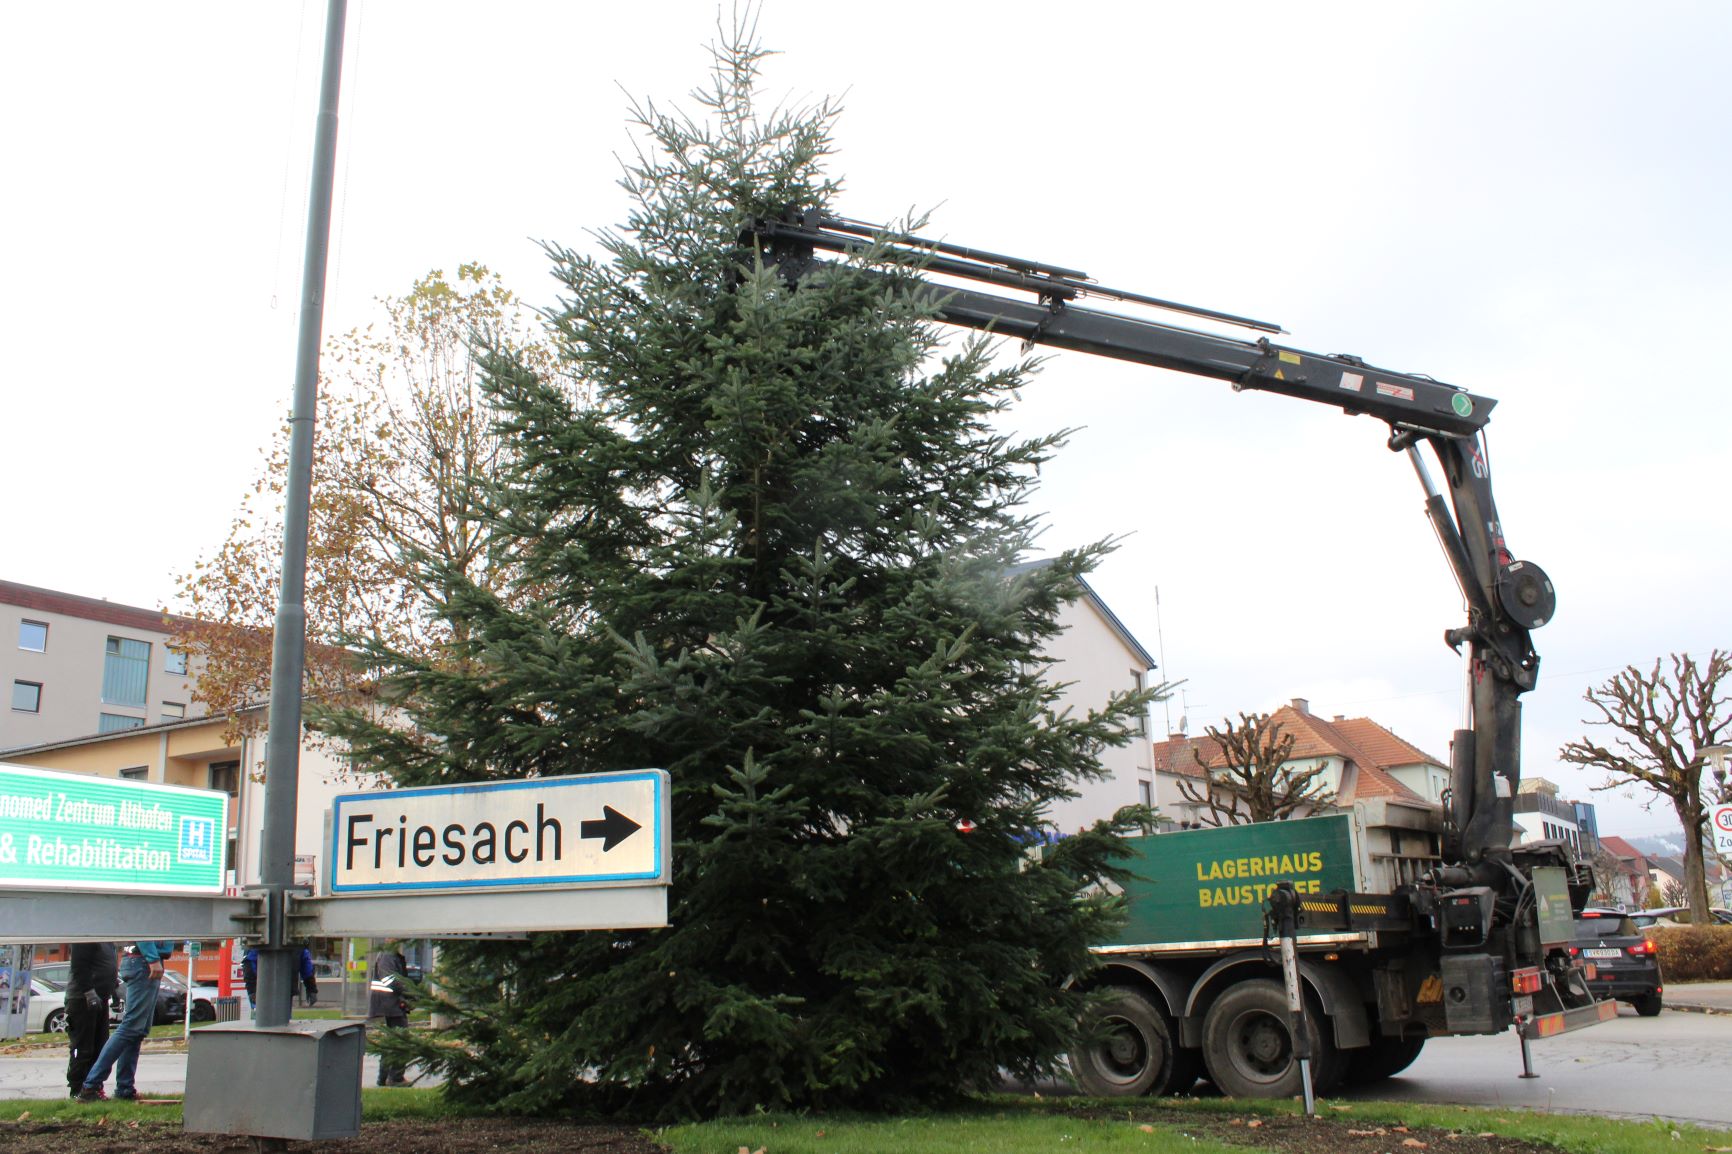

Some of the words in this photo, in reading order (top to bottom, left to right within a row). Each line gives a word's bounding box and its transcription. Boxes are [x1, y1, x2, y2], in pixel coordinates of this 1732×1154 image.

[55, 793, 115, 825] Zentrum
[118, 800, 172, 831] Althofen
[188, 821, 205, 847] H
[346, 803, 562, 870] Friesach
[0, 833, 18, 864] &
[27, 834, 171, 871] Rehabilitation
[1196, 852, 1323, 881] LAGERHAUS
[1198, 879, 1320, 908] BAUSTFE
